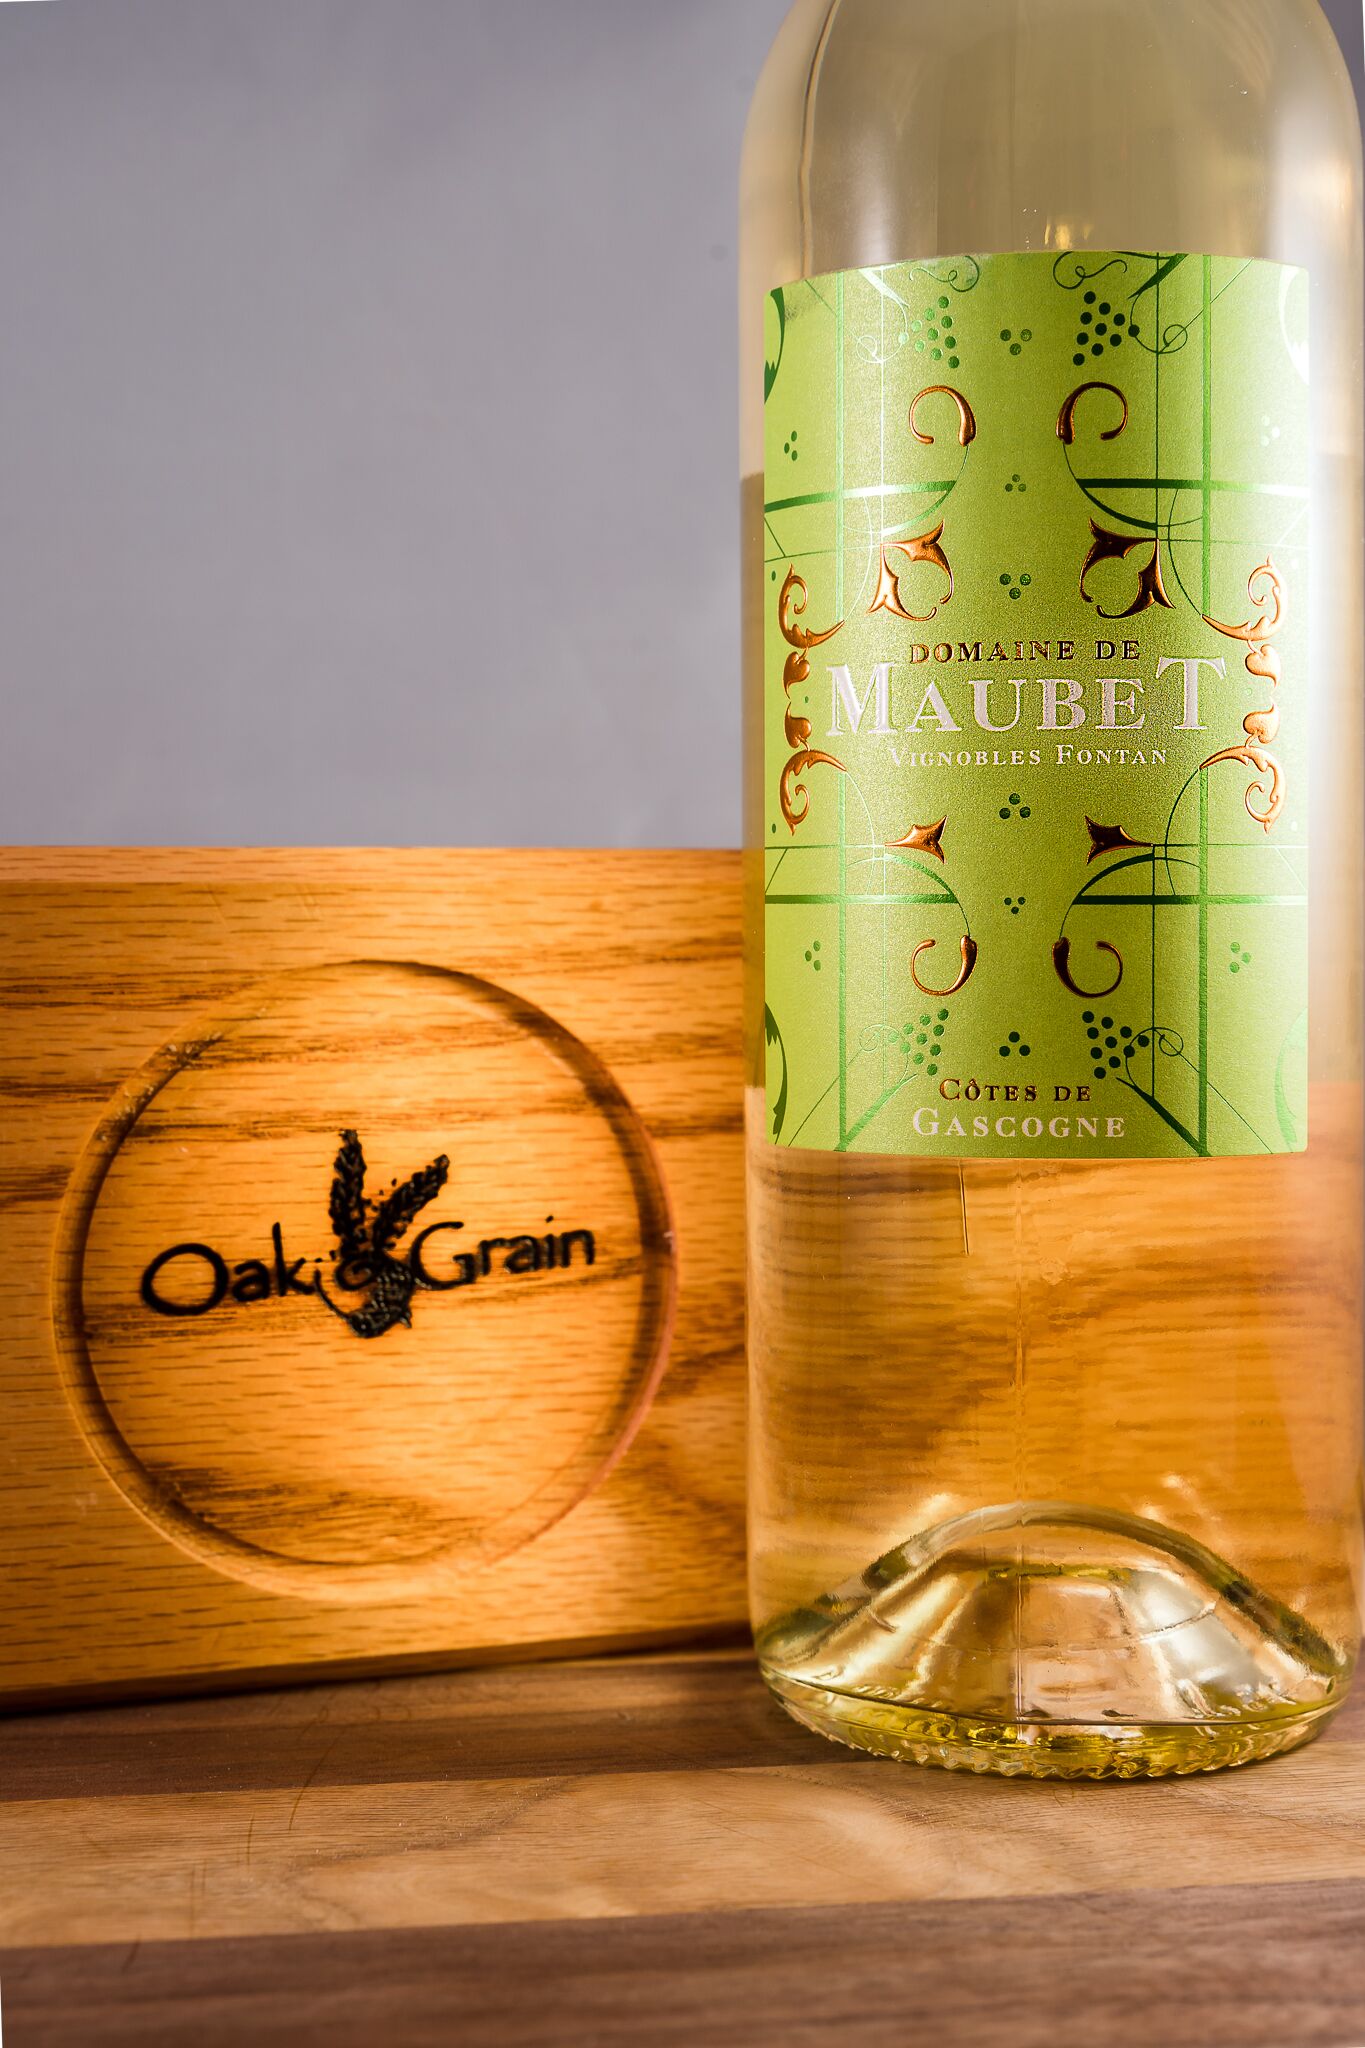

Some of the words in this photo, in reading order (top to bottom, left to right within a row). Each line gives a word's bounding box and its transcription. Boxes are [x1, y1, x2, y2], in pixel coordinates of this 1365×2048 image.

[910, 640, 1075, 664] DOMAINE
[1095, 640, 1141, 660] DE
[1054, 1085, 1091, 1102] DE
[140, 1222, 315, 1316] Oak
[409, 1214, 596, 1290] Grain
